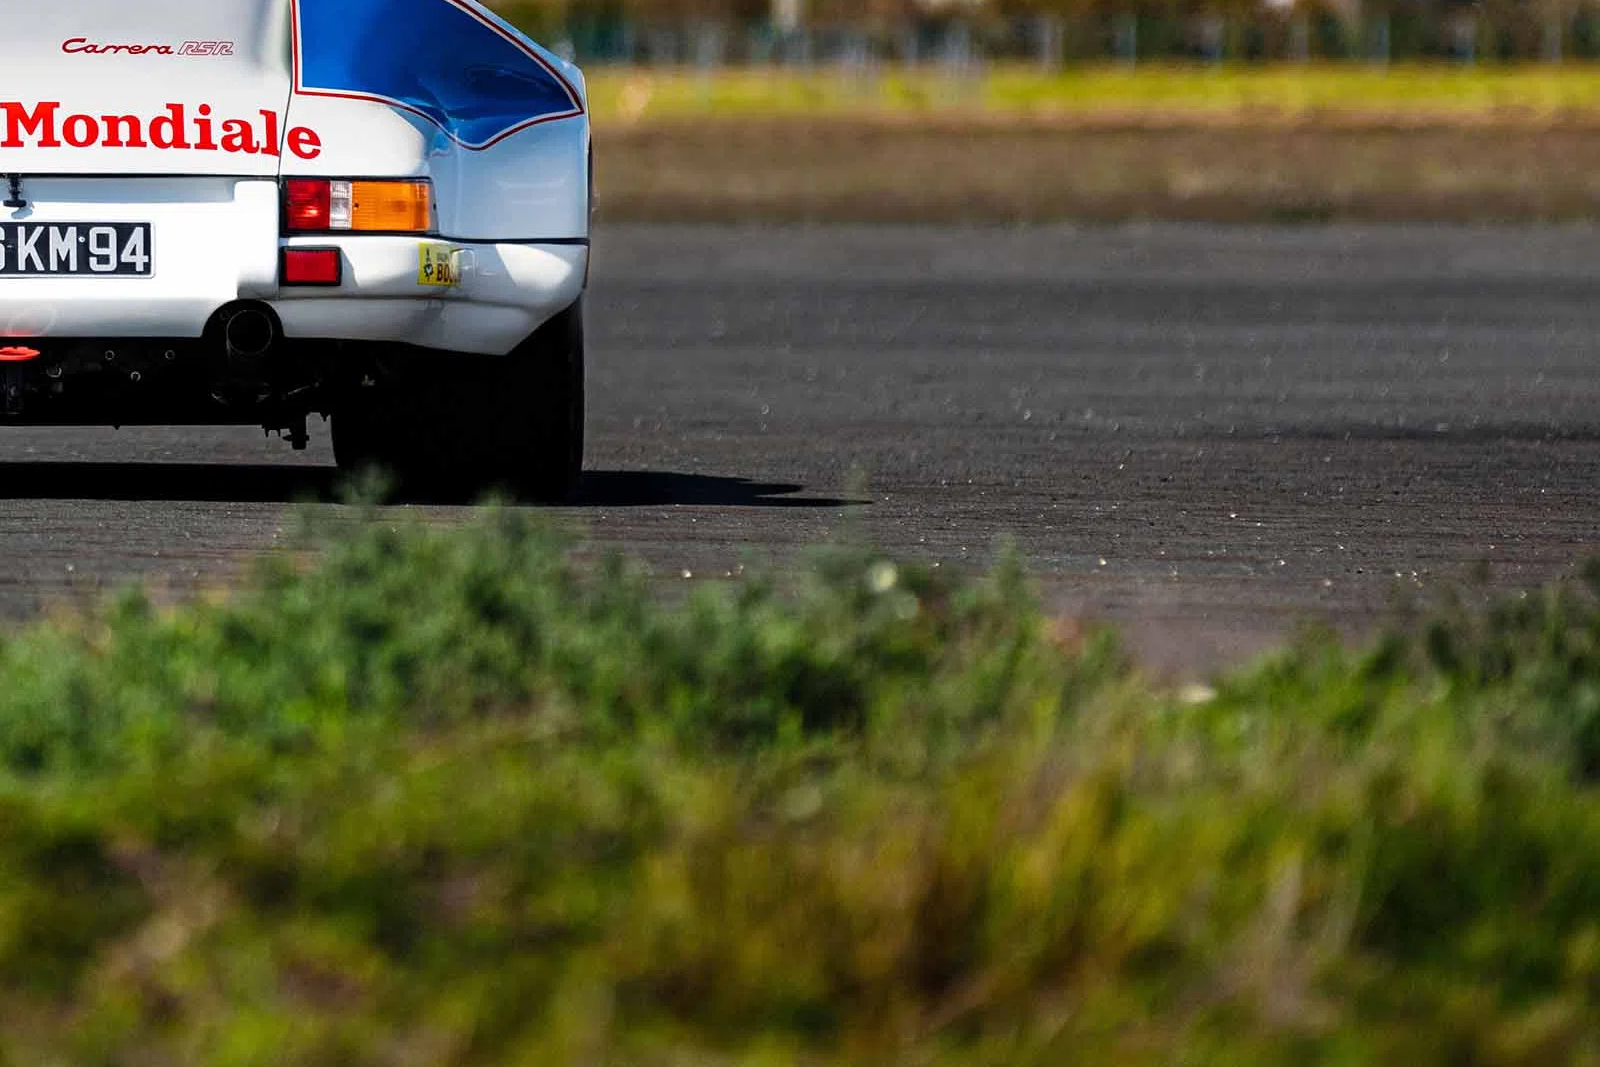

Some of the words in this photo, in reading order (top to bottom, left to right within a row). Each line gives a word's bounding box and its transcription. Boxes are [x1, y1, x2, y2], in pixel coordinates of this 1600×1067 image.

[62, 37, 174, 55] Carrera
[177, 40, 234, 56] RSR
[0, 102, 322, 159] Mondiale
[17, 226, 77, 271] KM
[88, 227, 149, 271] 94
